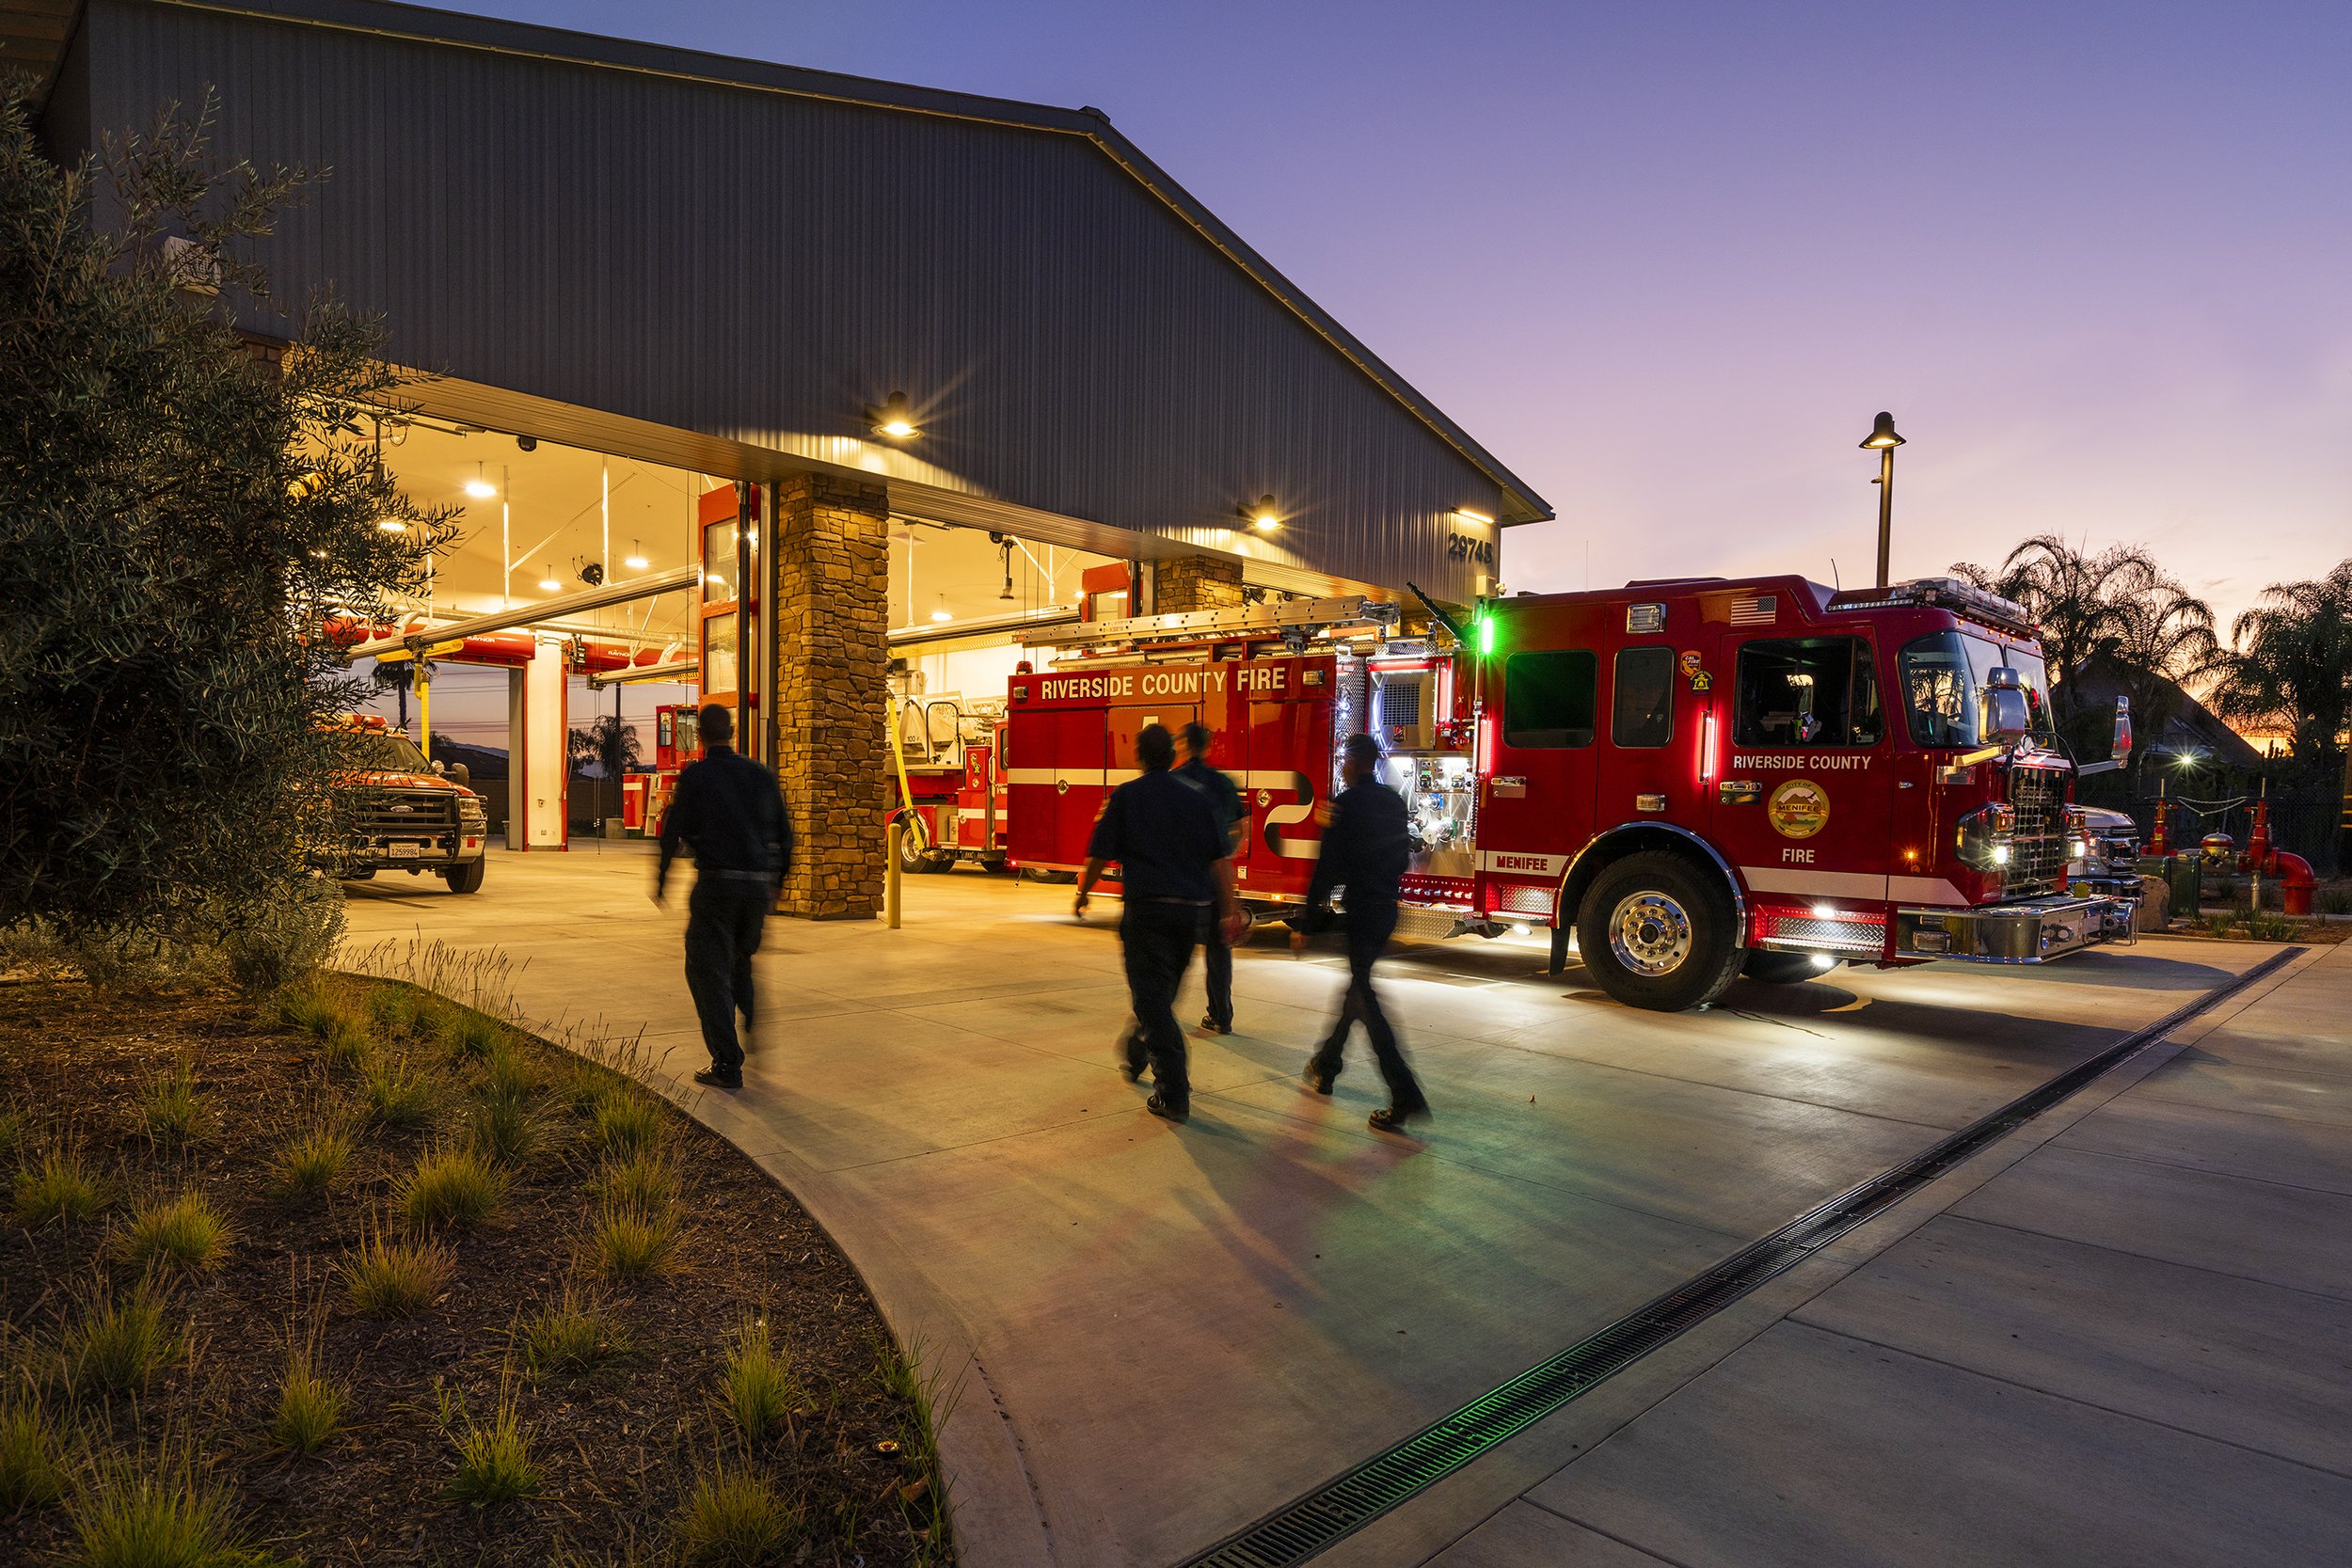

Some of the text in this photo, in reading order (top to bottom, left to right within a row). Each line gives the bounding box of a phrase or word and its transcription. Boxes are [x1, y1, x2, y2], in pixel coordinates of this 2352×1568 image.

[1449, 532, 1494, 564] 29745
[1041, 667, 1286, 700] RIVERSIDE COUNTY FIRE
[1733, 755, 1872, 770] RIVERSIDE COUNTY
[1778, 804, 1820, 813] MENIFEE
[1782, 848, 1816, 863] FIRE
[1496, 856, 1549, 871] MENIFEE
